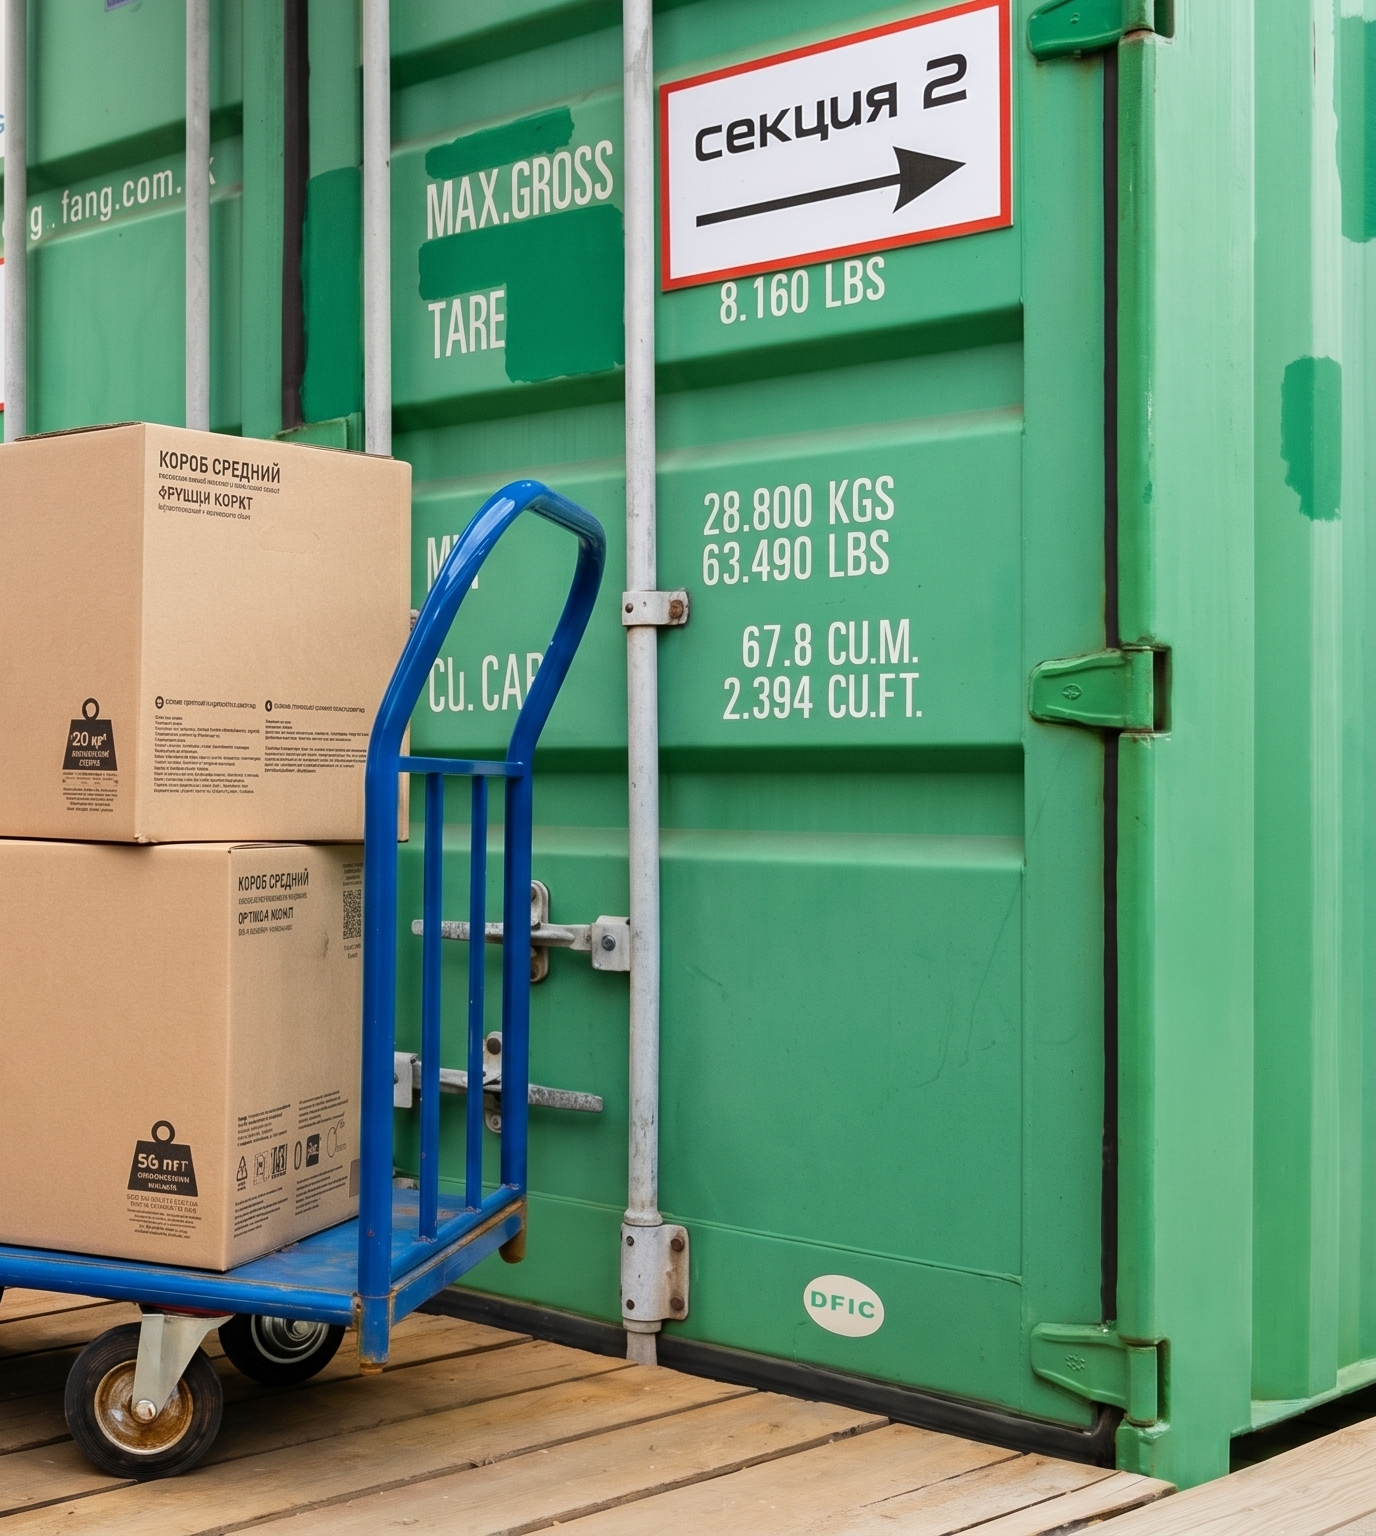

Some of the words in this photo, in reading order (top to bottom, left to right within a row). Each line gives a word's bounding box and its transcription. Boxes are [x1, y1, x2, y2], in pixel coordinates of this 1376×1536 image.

[695, 81, 898, 162] секция
[923, 53, 968, 110] 2
[427, 139, 614, 240] MAX.GROSS
[720, 269, 809, 325] 8.160
[825, 256, 886, 309] LBS
[428, 290, 505, 359] TARE
[159, 450, 209, 474] КОРОБ
[212, 458, 281, 484] СРЕДНИЙ
[703, 483, 812, 536] 28.800
[829, 475, 895, 525] KGS
[702, 536, 812, 586] 63.490
[829, 529, 890, 578] LBS
[742, 622, 812, 668] 67.8
[828, 618, 919, 666] CU.M.
[723, 674, 813, 720] 2.394
[828, 672, 923, 719] CU.FT.
[238, 874, 267, 891] КОРОБ
[269, 867, 309, 890] СРЕДНИЙ
[810, 1290, 875, 1319] DFIC
